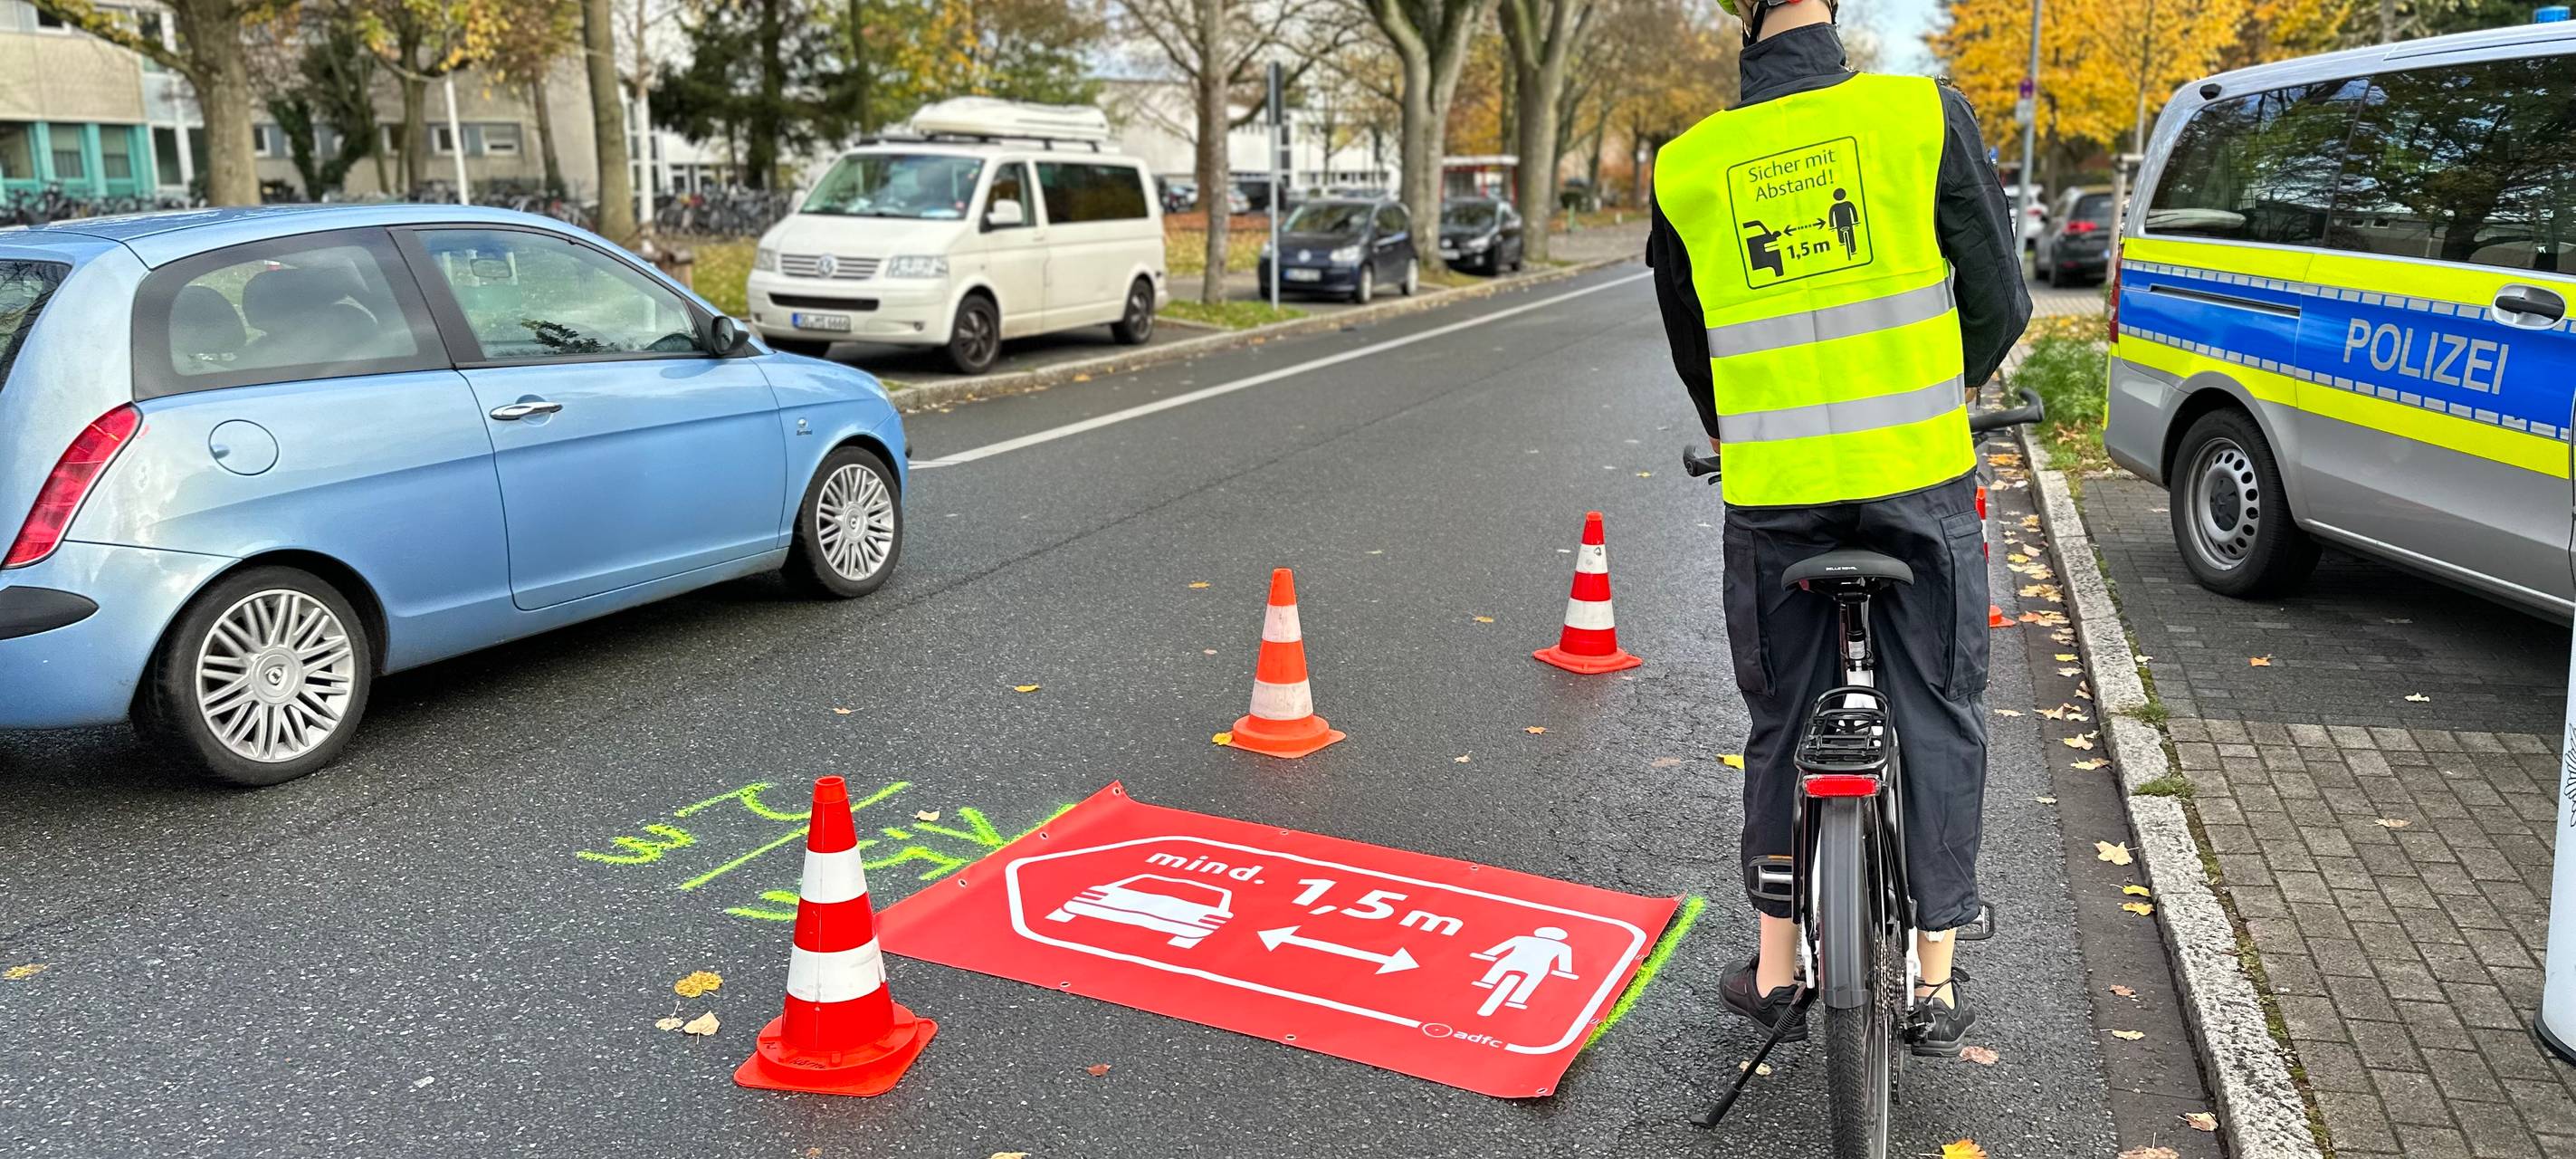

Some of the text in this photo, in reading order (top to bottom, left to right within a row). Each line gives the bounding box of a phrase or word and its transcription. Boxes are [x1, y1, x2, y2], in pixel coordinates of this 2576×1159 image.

[1748, 149, 1837, 183] Sicher mit
[1755, 168, 1834, 202] Abstand!
[2342, 317, 2509, 395] POLIZEI
[1145, 852, 1265, 885] mind.
[1454, 1030, 1503, 1049] adfc
